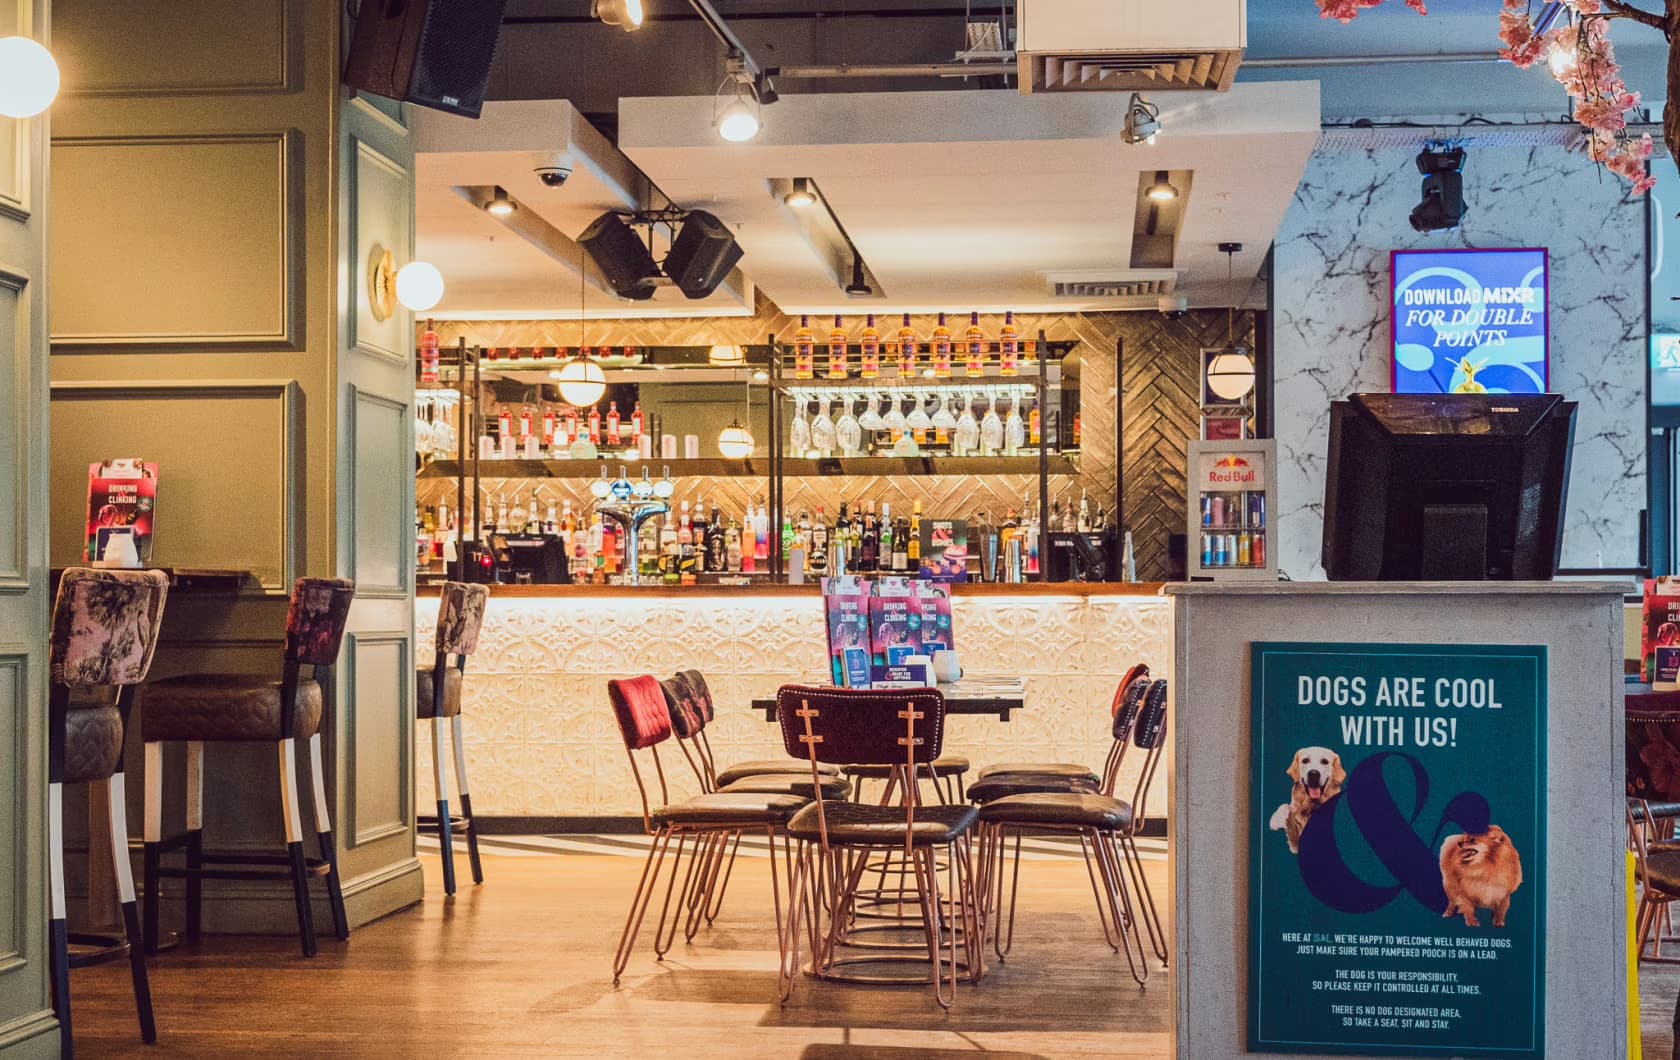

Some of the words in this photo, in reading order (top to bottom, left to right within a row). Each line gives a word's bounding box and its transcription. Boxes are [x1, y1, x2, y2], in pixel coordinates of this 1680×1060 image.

[1404, 287, 1480, 305] DOWNLOAD
[1483, 287, 1535, 304] MIXR
[1405, 310, 1446, 327] FOR
[1452, 308, 1534, 326] DOUBLE
[1433, 330, 1507, 348] POINTS
[1209, 471, 1232, 482] Red
[1233, 470, 1255, 482] Bull
[1298, 676, 1366, 706] DOGS
[1375, 677, 1426, 707] ARE
[1435, 678, 1502, 708] COOL
[1340, 716, 1404, 746] WITH
[1414, 717, 1457, 747] US!
[1282, 933, 1300, 942] HERE
[1303, 934, 1311, 943] AT
[1334, 934, 1357, 944] WE'RE
[1359, 935, 1383, 945] HAPPY
[1385, 936, 1394, 945] TO
[1395, 936, 1432, 946] WELCOME
[1434, 937, 1453, 947] WELL
[1455, 938, 1488, 948] BEHAVED
[1296, 945, 1314, 955] JUST
[1316, 946, 1336, 955] MAKE
[1338, 946, 1357, 956] SURE
[1359, 947, 1379, 956] YOUR
[1381, 948, 1420, 958] PAMPERED
[1422, 949, 1446, 959] POOCH
[1448, 950, 1456, 959] IS
[1457, 950, 1468, 959] ON
[1470, 950, 1475, 959] A
[1335, 969, 1349, 979] THE
[1350, 970, 1366, 980] DOG
[1367, 971, 1375, 980] IS
[1377, 971, 1397, 981] YOUR
[1312, 981, 1322, 990] SO
[1324, 981, 1351, 991] PLEASE
[1353, 982, 1372, 992] KEEP
[1373, 983, 1380, 992] IT
[1382, 983, 1429, 993] CONTROLLED
[1431, 985, 1439, 994] AT
[1441, 985, 1455, 995] ALL
[1331, 1005, 1354, 1015] THERE
[1355, 1006, 1363, 1015] IS
[1365, 1006, 1376, 1016] NO
[1377, 1007, 1392, 1016] DOG
[1394, 1007, 1438, 1018] DESIGNATED
[1342, 1017, 1352, 1027] SO
[1355, 1018, 1372, 1028] TAKE
[1373, 1018, 1379, 1028] A
[1401, 1019, 1413, 1029] SIT
[1414, 1019, 1430, 1029] AND
